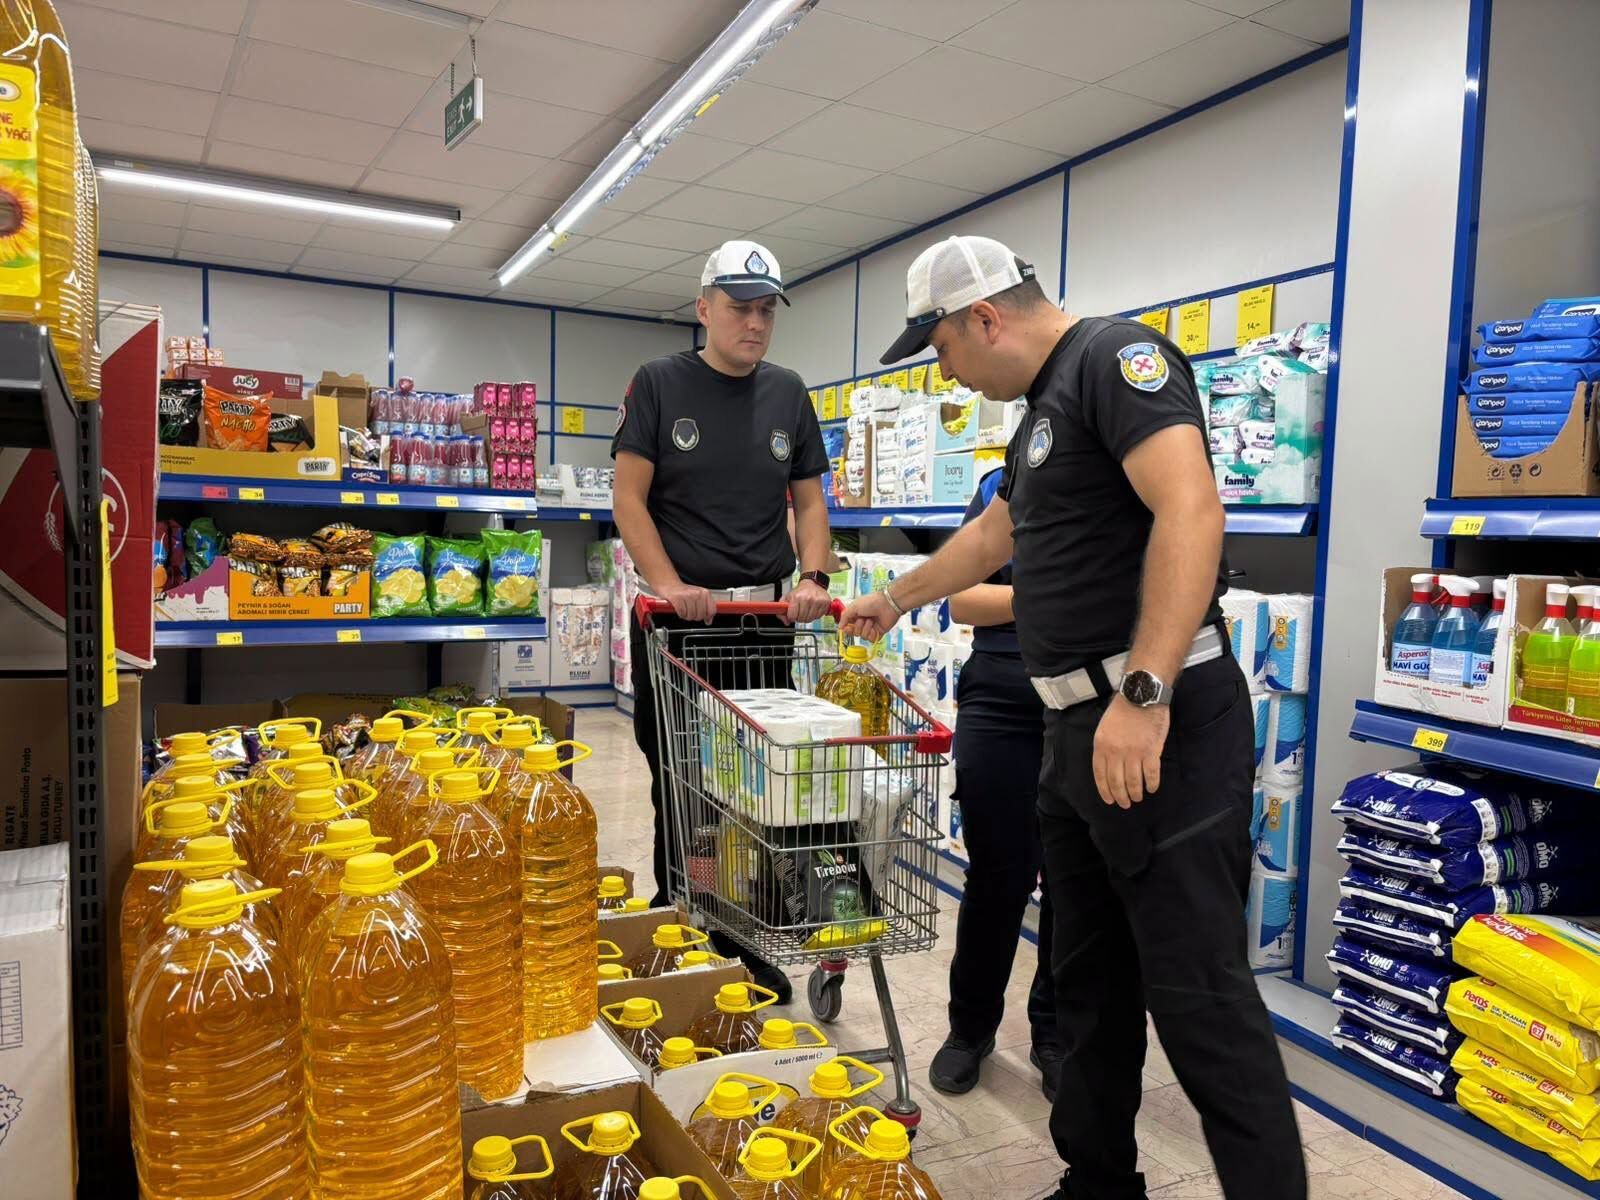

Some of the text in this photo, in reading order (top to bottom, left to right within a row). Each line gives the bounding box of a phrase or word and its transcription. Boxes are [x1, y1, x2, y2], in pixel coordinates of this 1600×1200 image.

[219, 400, 254, 415] PARTY
[304, 461, 330, 473] PARTY
[1224, 475, 1255, 487] family
[1464, 523, 1480, 531] 119
[333, 602, 363, 614] PARTY
[1398, 650, 1428, 660] Asperox
[1427, 737, 1443, 748] 399
[5, 805, 15, 844] RIGATE
[1369, 953, 1393, 970] OMO
[1463, 990, 1489, 1008] Peros
[1375, 1035, 1398, 1051] OMO
